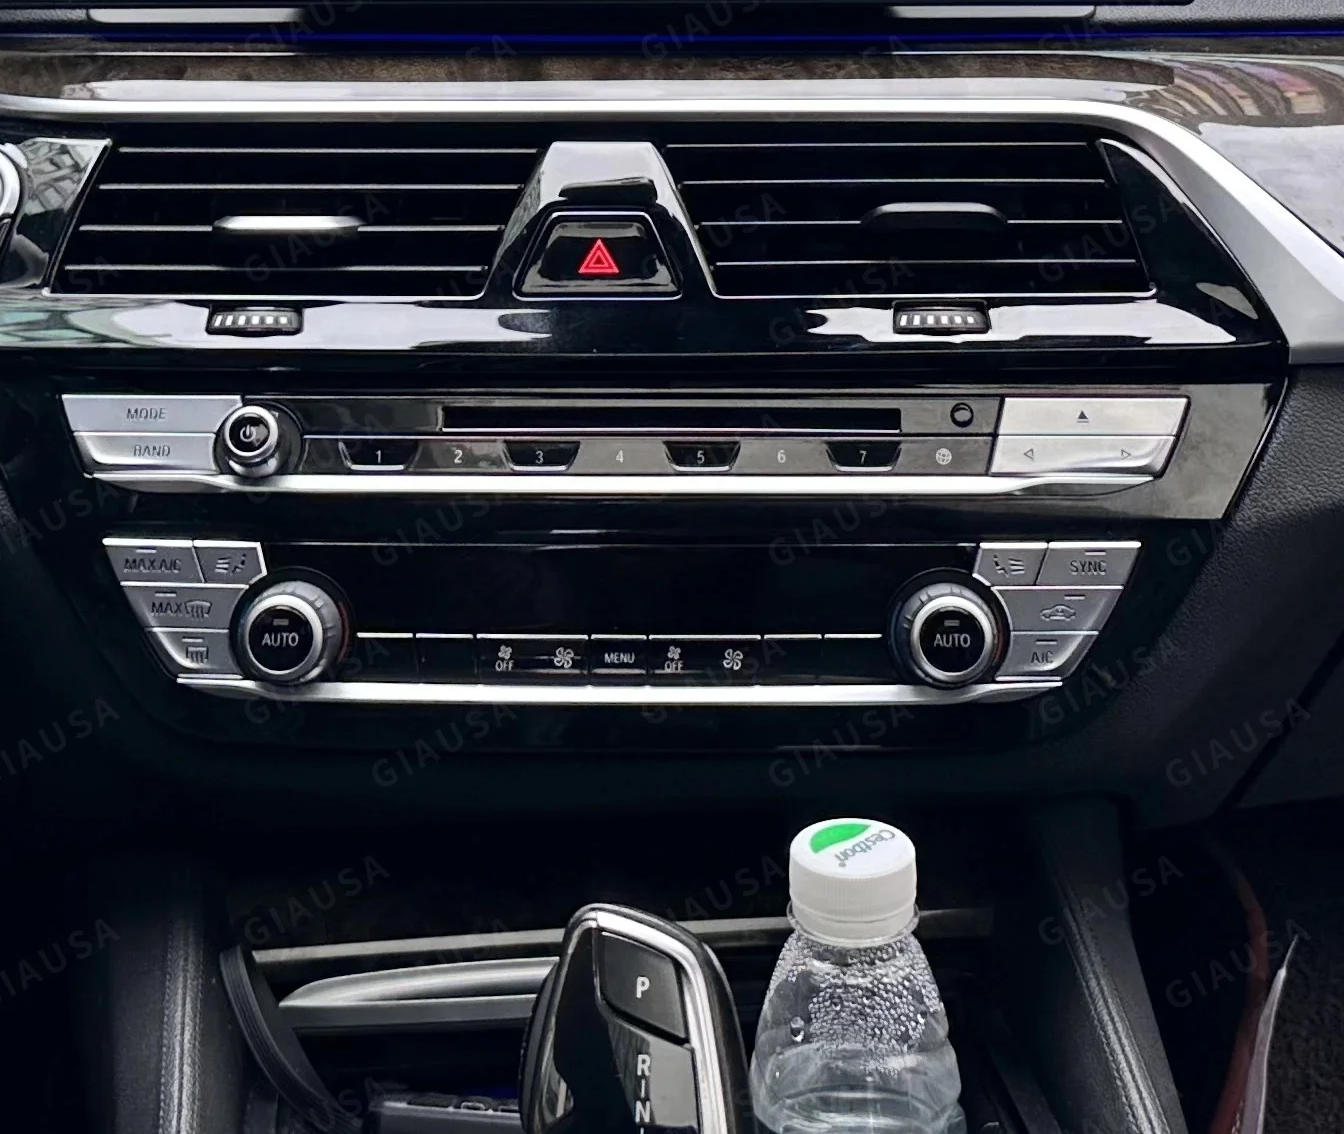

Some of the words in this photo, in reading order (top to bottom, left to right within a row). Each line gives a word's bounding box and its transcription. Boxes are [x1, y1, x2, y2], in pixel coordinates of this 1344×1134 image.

[126, 407, 168, 420] MODE
[133, 445, 171, 457] BAND
[375, 450, 382, 464] 1
[453, 449, 463, 464] 2
[534, 450, 544, 464] 3
[615, 449, 625, 464] 4
[696, 449, 705, 464] 5
[777, 449, 786, 464] 6
[859, 449, 867, 464] 7
[124, 558, 156, 572] MAX
[1069, 560, 1107, 574] SYNC
[150, 601, 184, 615] MAX
[261, 632, 299, 647] AUTO
[933, 633, 971, 648] AUTO
[604, 652, 635, 664] MENU
[1031, 651, 1054, 664] A/C
[495, 660, 514, 671] OFF
[664, 660, 684, 672] OFF
[636, 976, 650, 998] P
[636, 1053, 651, 1076] R
[635, 1100, 651, 1123] N
